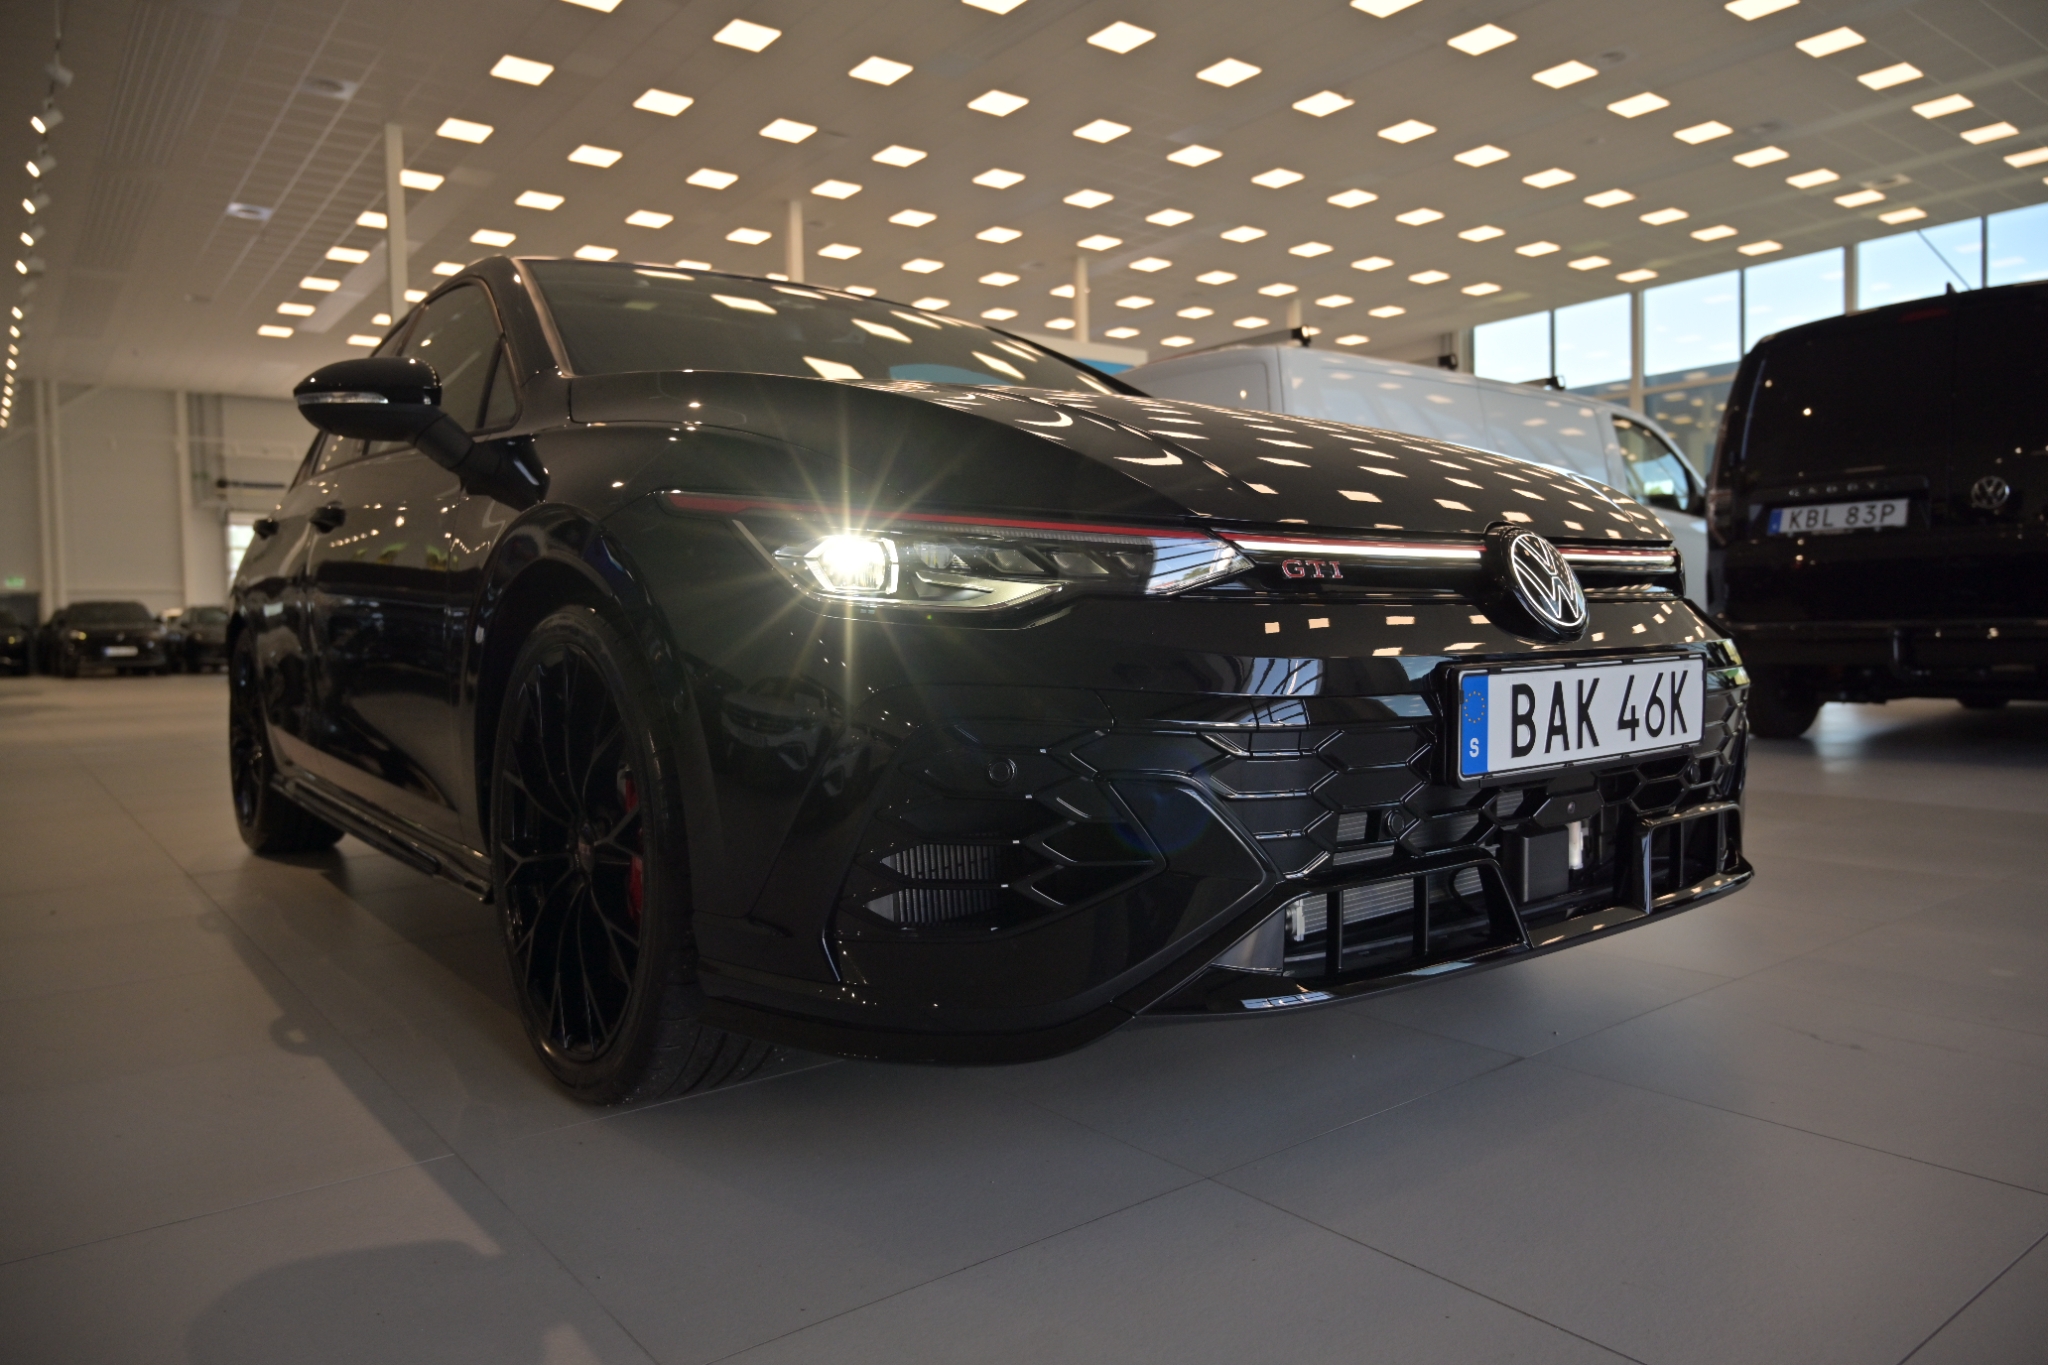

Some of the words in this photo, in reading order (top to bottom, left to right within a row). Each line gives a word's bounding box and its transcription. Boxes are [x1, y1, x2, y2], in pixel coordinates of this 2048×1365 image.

[1788, 508, 1833, 529] KBL
[1845, 503, 1895, 525] 83P
[1281, 559, 1344, 579] GTI
[1510, 677, 1600, 758] BAK
[1617, 669, 1688, 741] 46K
[1469, 738, 1479, 758] S
